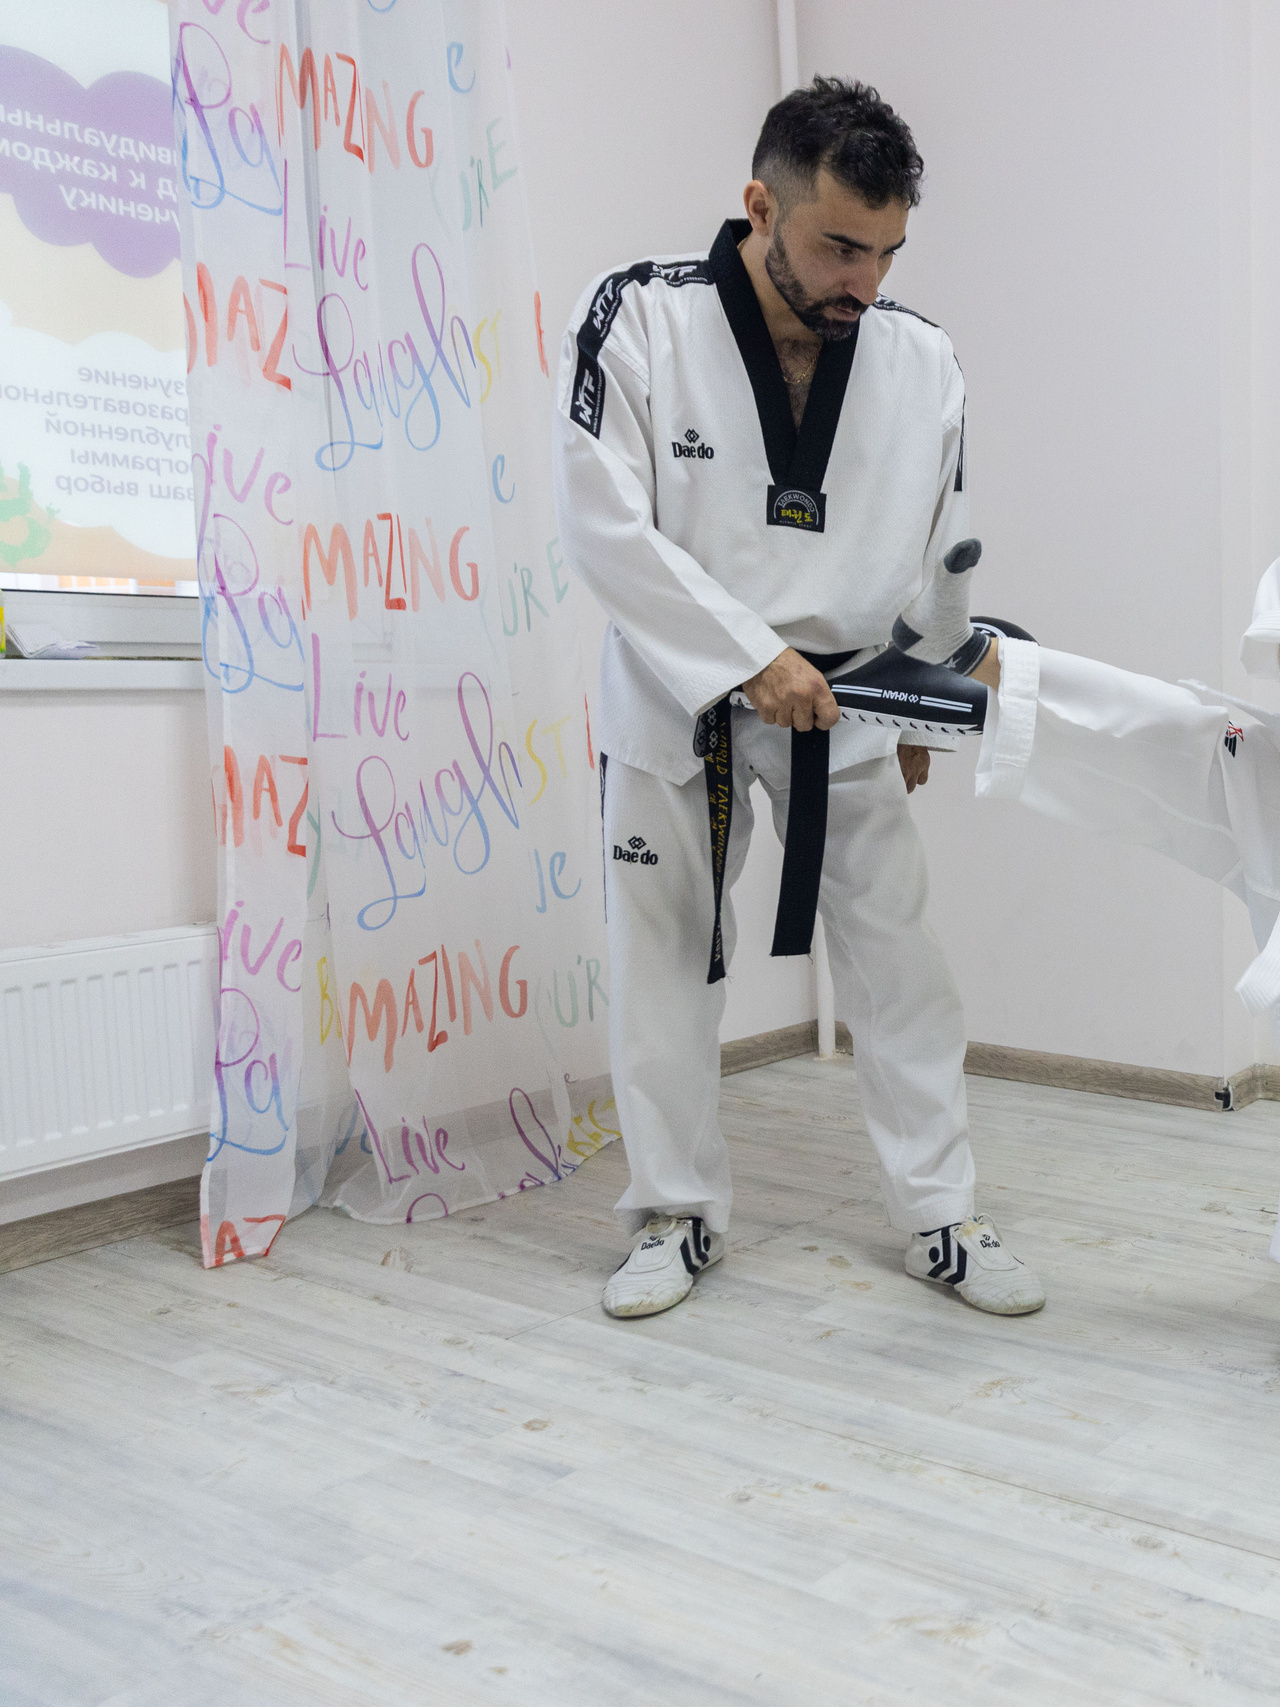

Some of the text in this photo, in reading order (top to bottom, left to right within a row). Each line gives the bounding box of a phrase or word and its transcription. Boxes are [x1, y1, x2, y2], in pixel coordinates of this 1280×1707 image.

[283, 158, 369, 291] Live
[592, 278, 614, 330] WTF
[575, 368, 595, 426] WTF
[671, 441, 715, 459] Daedo
[777, 493, 815, 513] TAEKWONDO
[312, 632, 410, 742] Live
[882, 689, 909, 702] KHAN
[612, 844, 659, 866] Daedo
[354, 1088, 466, 1184] Live
[641, 1237, 665, 1251] Daedo
